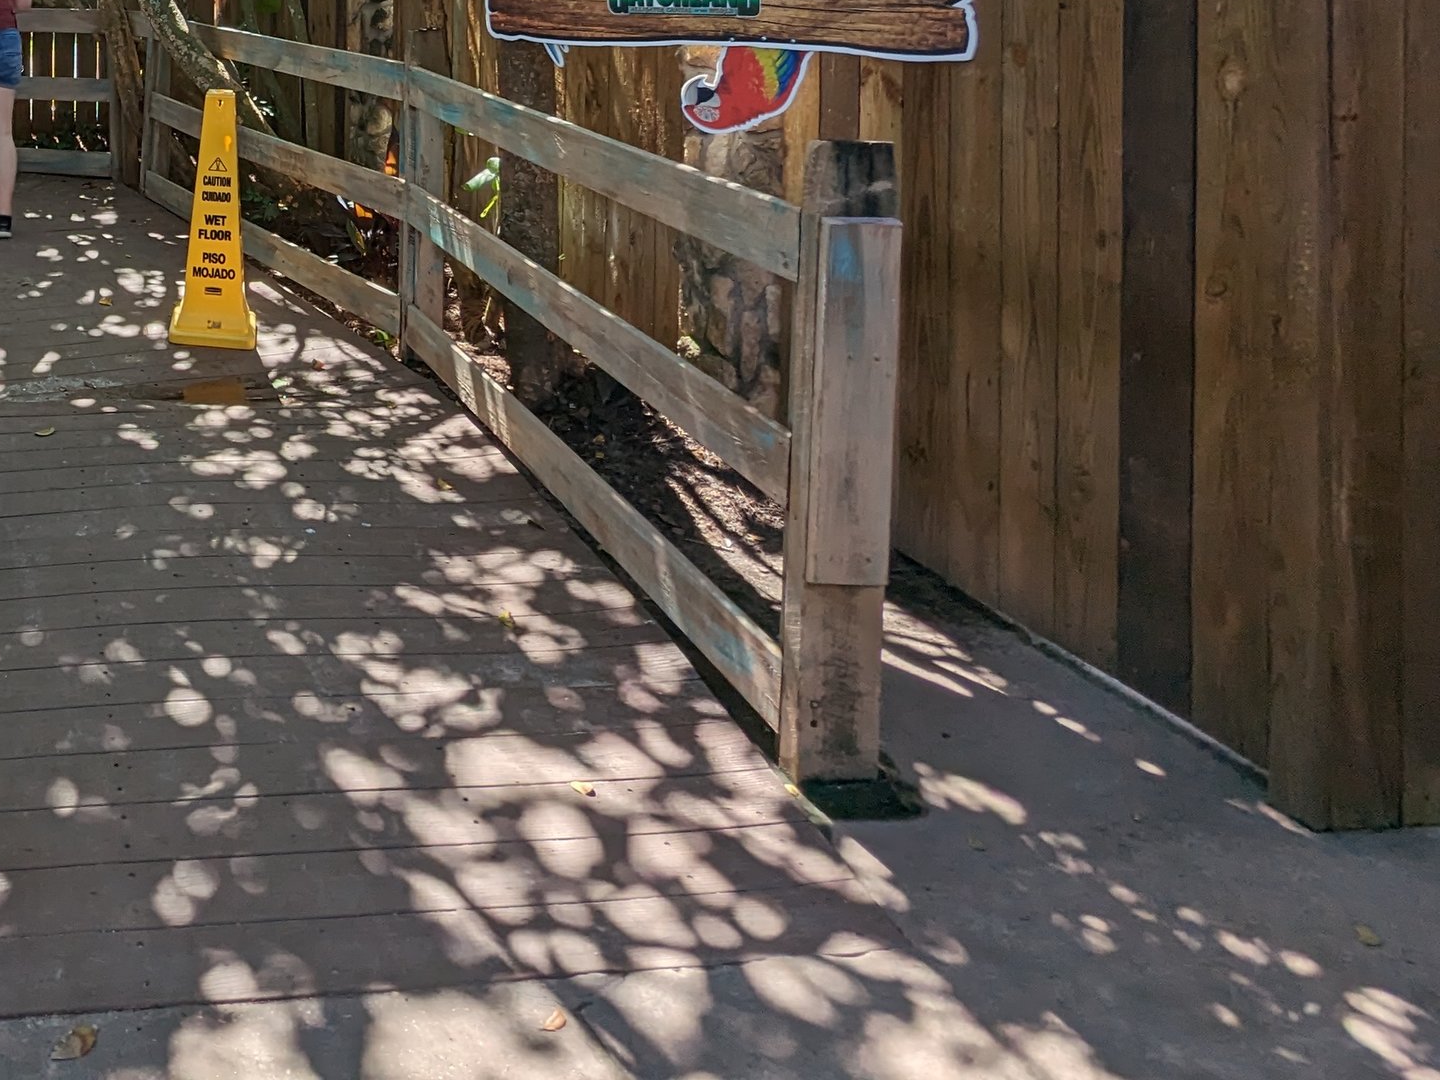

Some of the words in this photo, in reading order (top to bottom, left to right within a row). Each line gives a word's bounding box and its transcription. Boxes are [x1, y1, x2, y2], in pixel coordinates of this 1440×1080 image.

[203, 175, 232, 188] CAUTION
[202, 190, 232, 203] CUIDADO
[204, 214, 227, 226] WET
[198, 228, 232, 241] FLOOR
[202, 252, 226, 265] PISO
[192, 266, 236, 280] MOJADO
